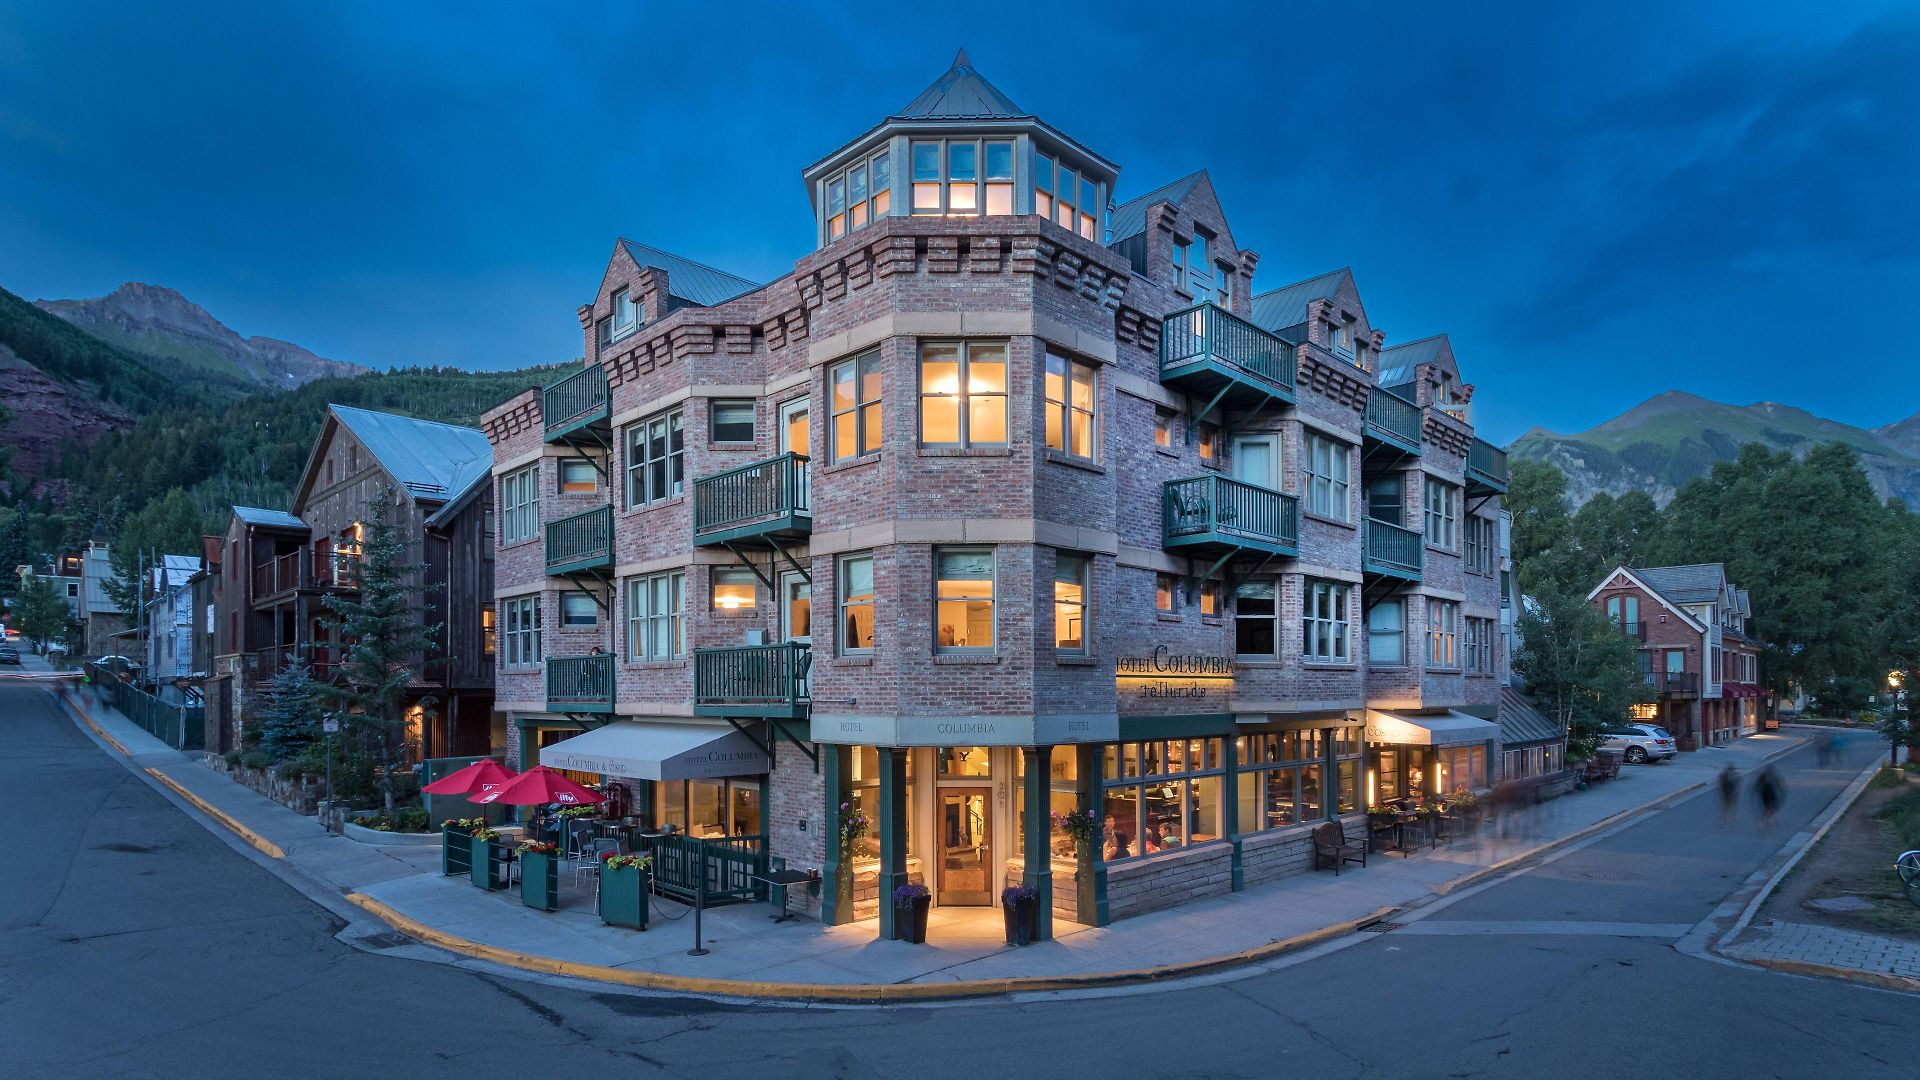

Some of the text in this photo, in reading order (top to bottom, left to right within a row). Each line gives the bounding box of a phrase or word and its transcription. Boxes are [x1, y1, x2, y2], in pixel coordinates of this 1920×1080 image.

[1154, 645, 1234, 674] COLUMBIA
[1140, 682, 1207, 699] telluride
[840, 722, 863, 732] HOTEL
[937, 723, 995, 734] COLUMBIA
[1068, 721, 1090, 731] HOTEL
[708, 751, 759, 762] COLUMBIA
[567, 754, 600, 771] COLUMBIA
[560, 794, 574, 803] illy
